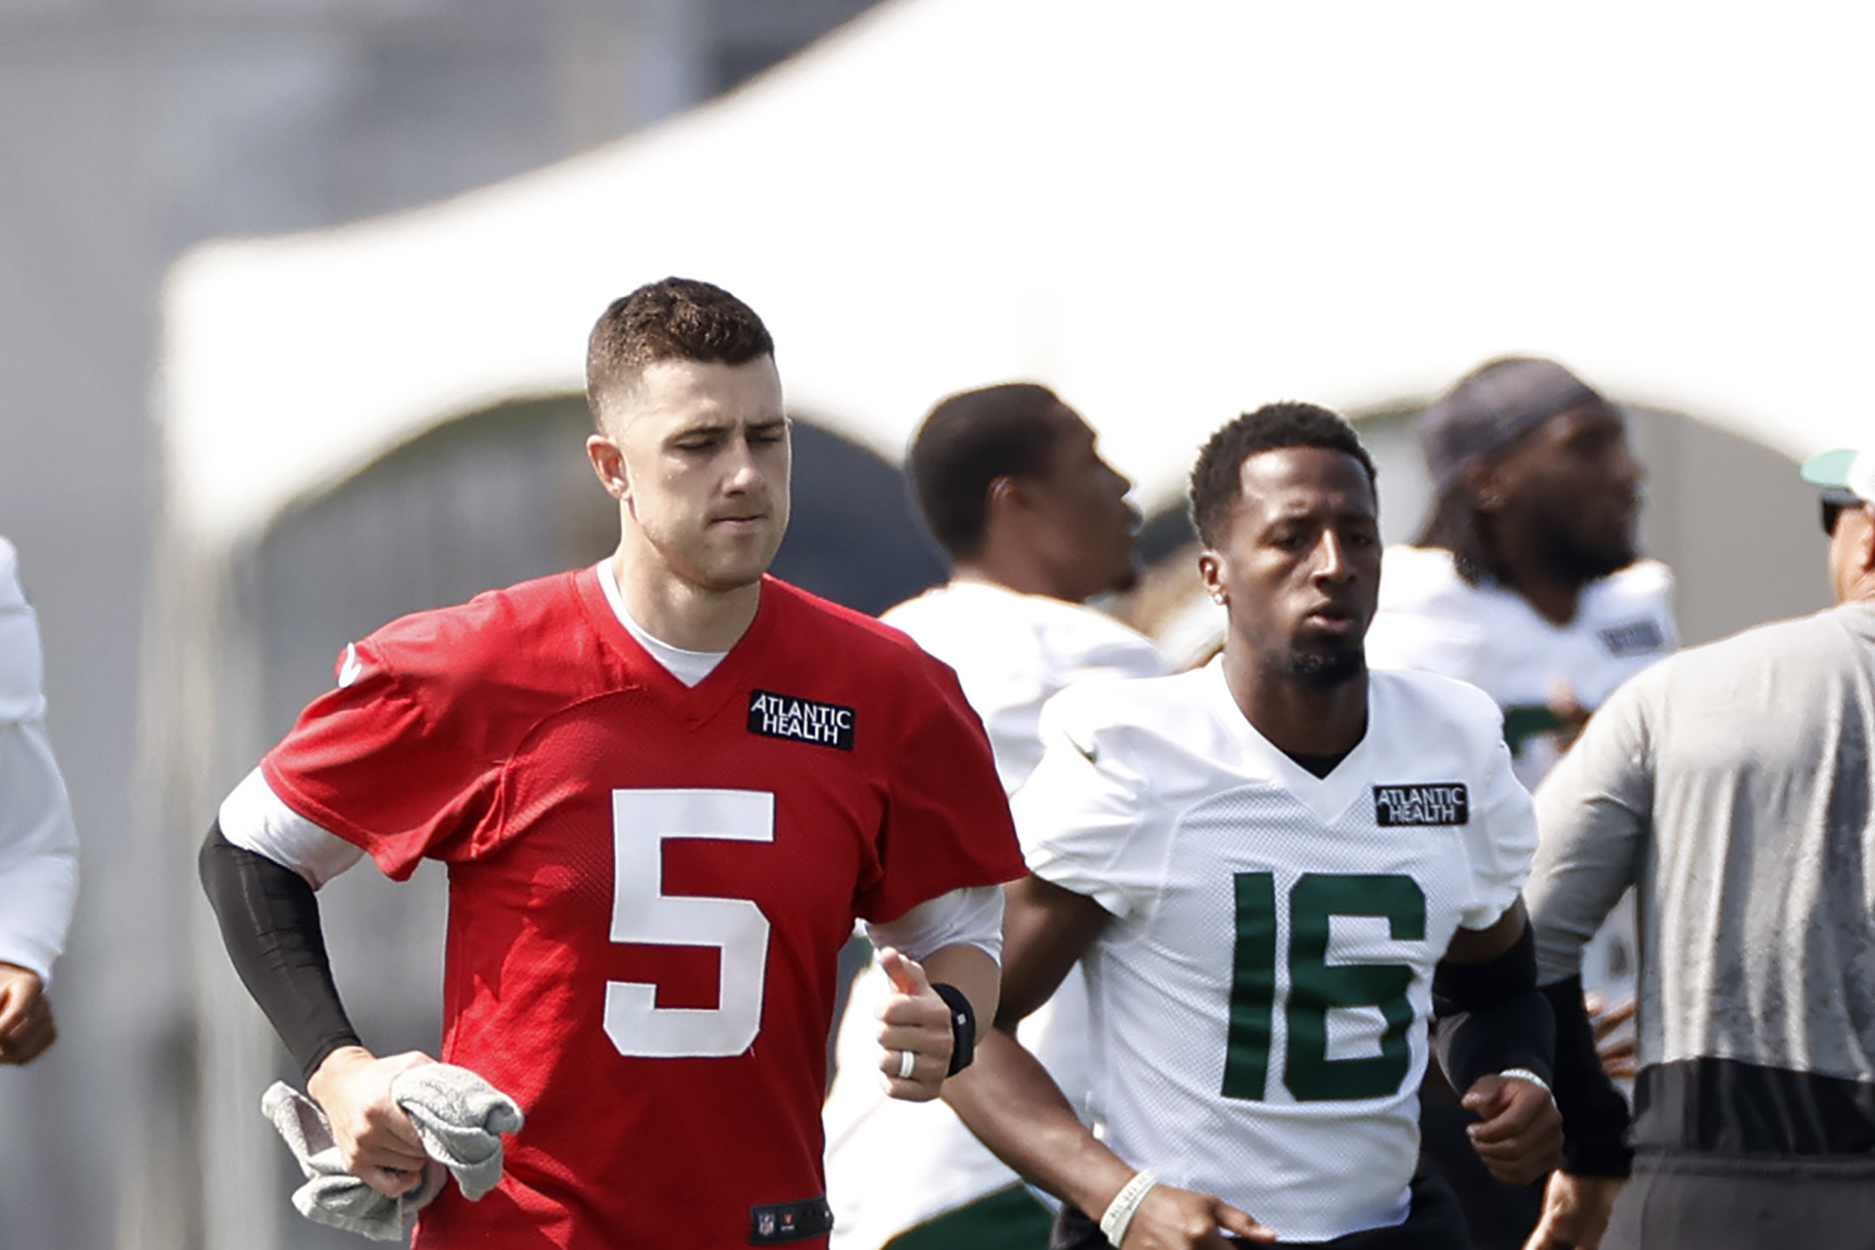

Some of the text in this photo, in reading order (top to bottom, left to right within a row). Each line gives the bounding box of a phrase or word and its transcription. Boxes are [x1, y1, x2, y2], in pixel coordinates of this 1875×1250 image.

[750, 694, 852, 730] ATLANTIC
[763, 713, 839, 745] HEALTH
[1378, 787, 1465, 806] ATLANTIC
[1389, 804, 1456, 823] HEALTH
[603, 788, 775, 1058] 5
[1221, 871, 1427, 1103] 16
